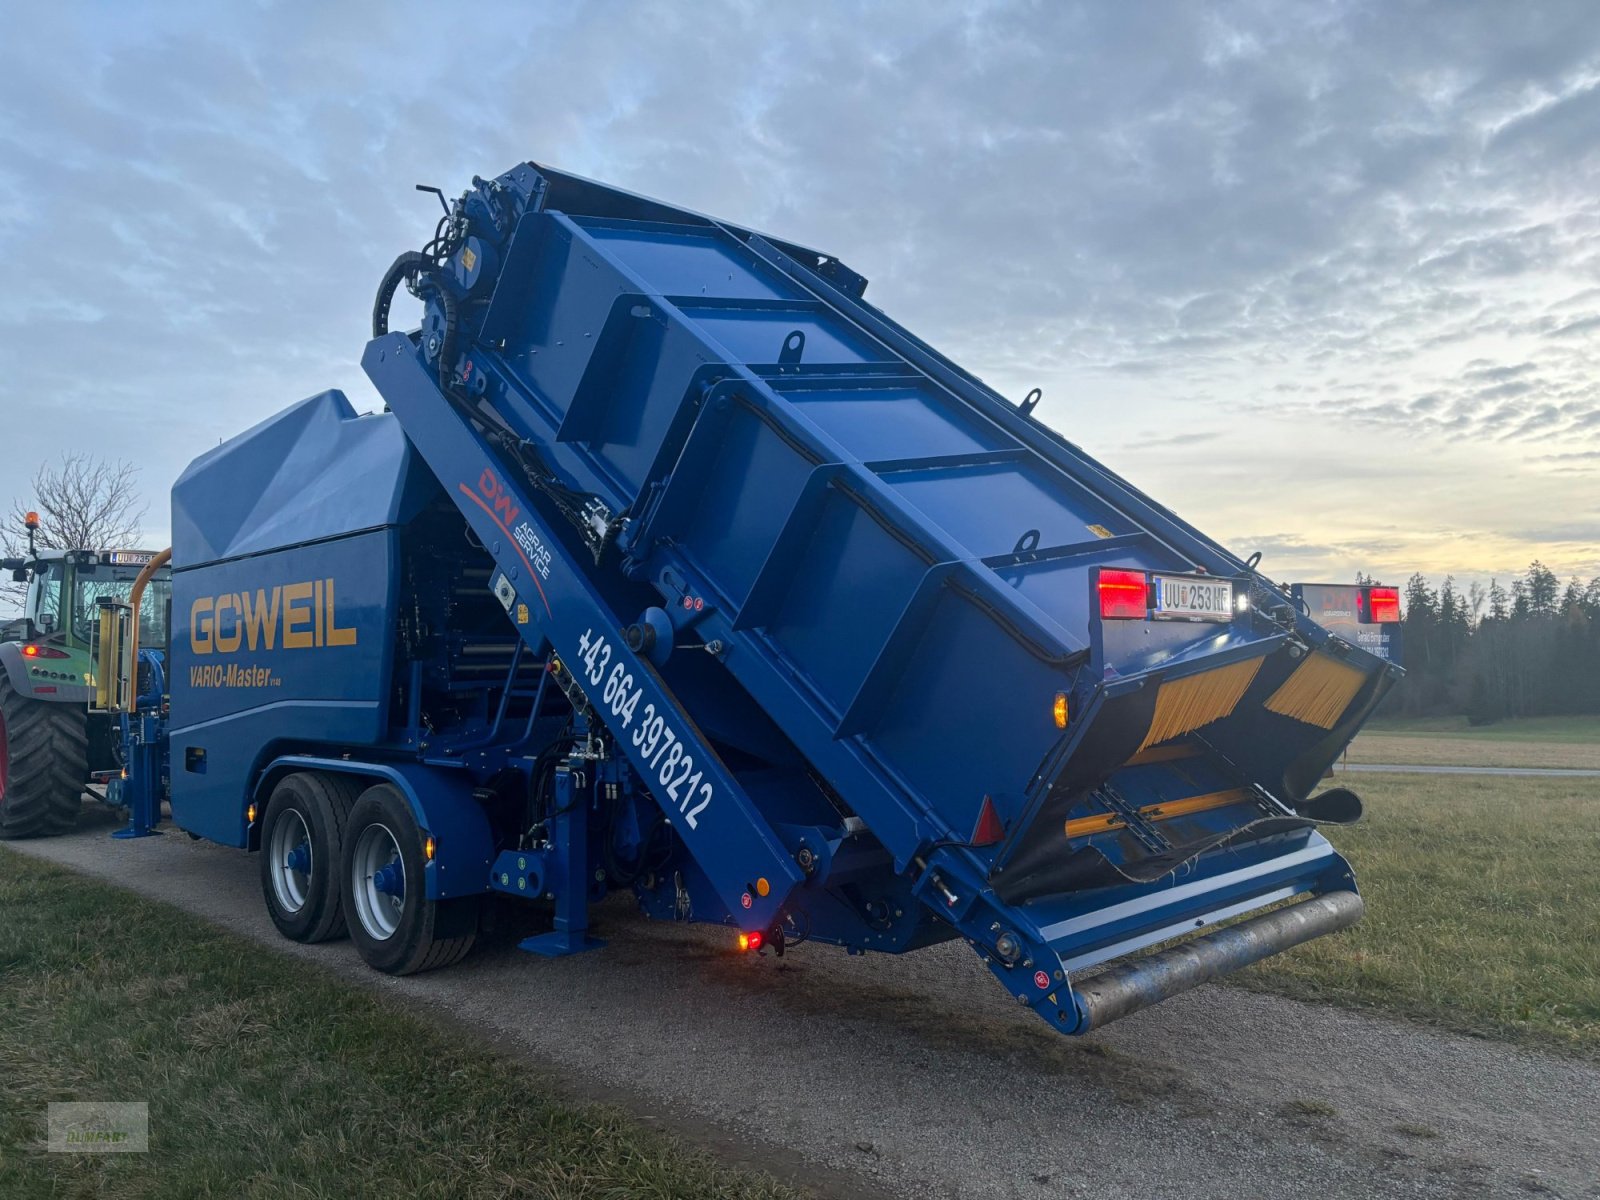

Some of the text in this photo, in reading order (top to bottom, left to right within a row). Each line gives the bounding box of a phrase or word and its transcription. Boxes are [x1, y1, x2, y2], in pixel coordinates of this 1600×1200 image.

[513, 526, 550, 580] SERVICE
[520, 522, 551, 565] AGRAR
[1164, 583, 1180, 609] UU
[1189, 585, 1212, 610] 253
[190, 663, 272, 688] VARIO-Master
[578, 628, 713, 830] +43 664 3978212
